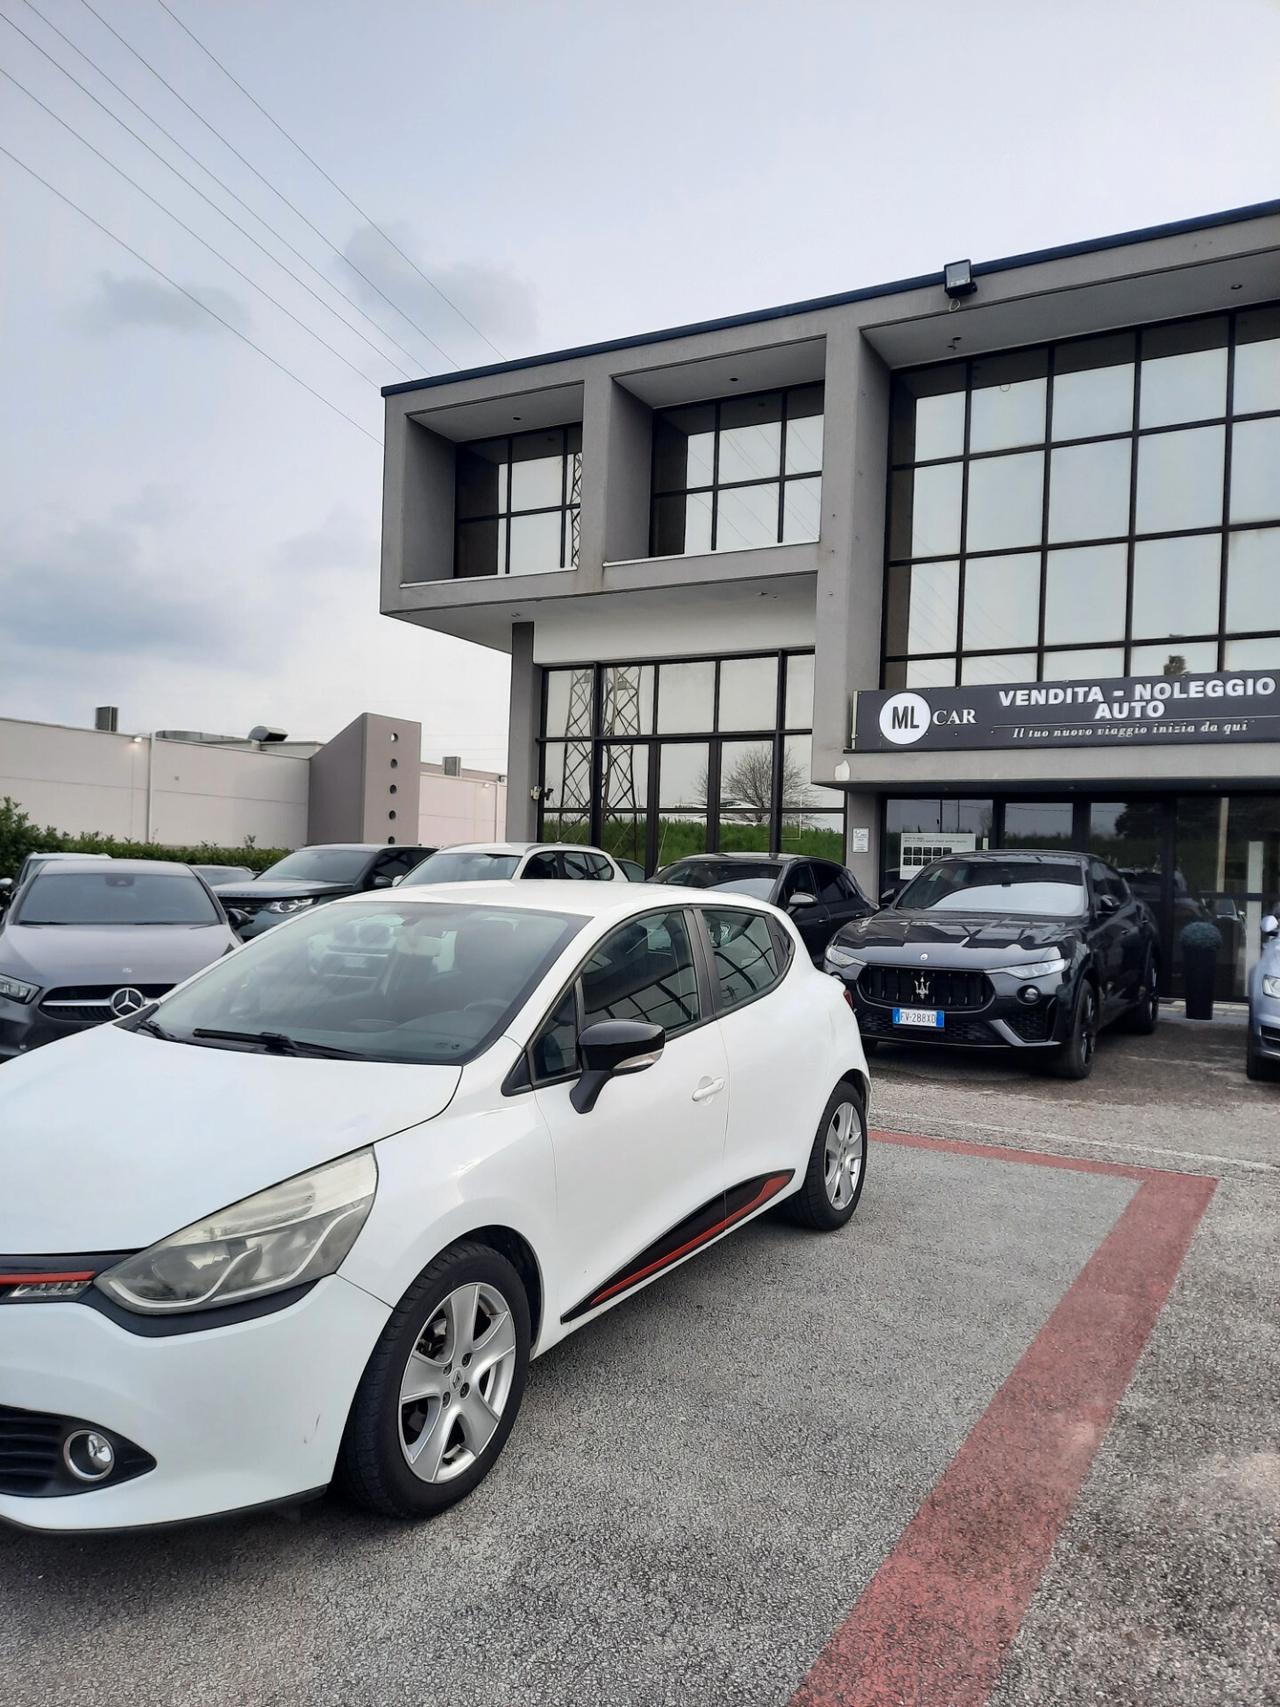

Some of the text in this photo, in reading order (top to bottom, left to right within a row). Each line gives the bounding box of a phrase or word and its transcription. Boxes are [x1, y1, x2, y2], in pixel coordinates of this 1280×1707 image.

[999, 686, 1105, 706] VENDITA
[1134, 677, 1276, 700] NOLEGGIO
[892, 706, 977, 729] ML CAR
[1094, 701, 1165, 720] AUTO
[1012, 720, 1249, 738] Il tuo nuovo viaggio inizia da qui
